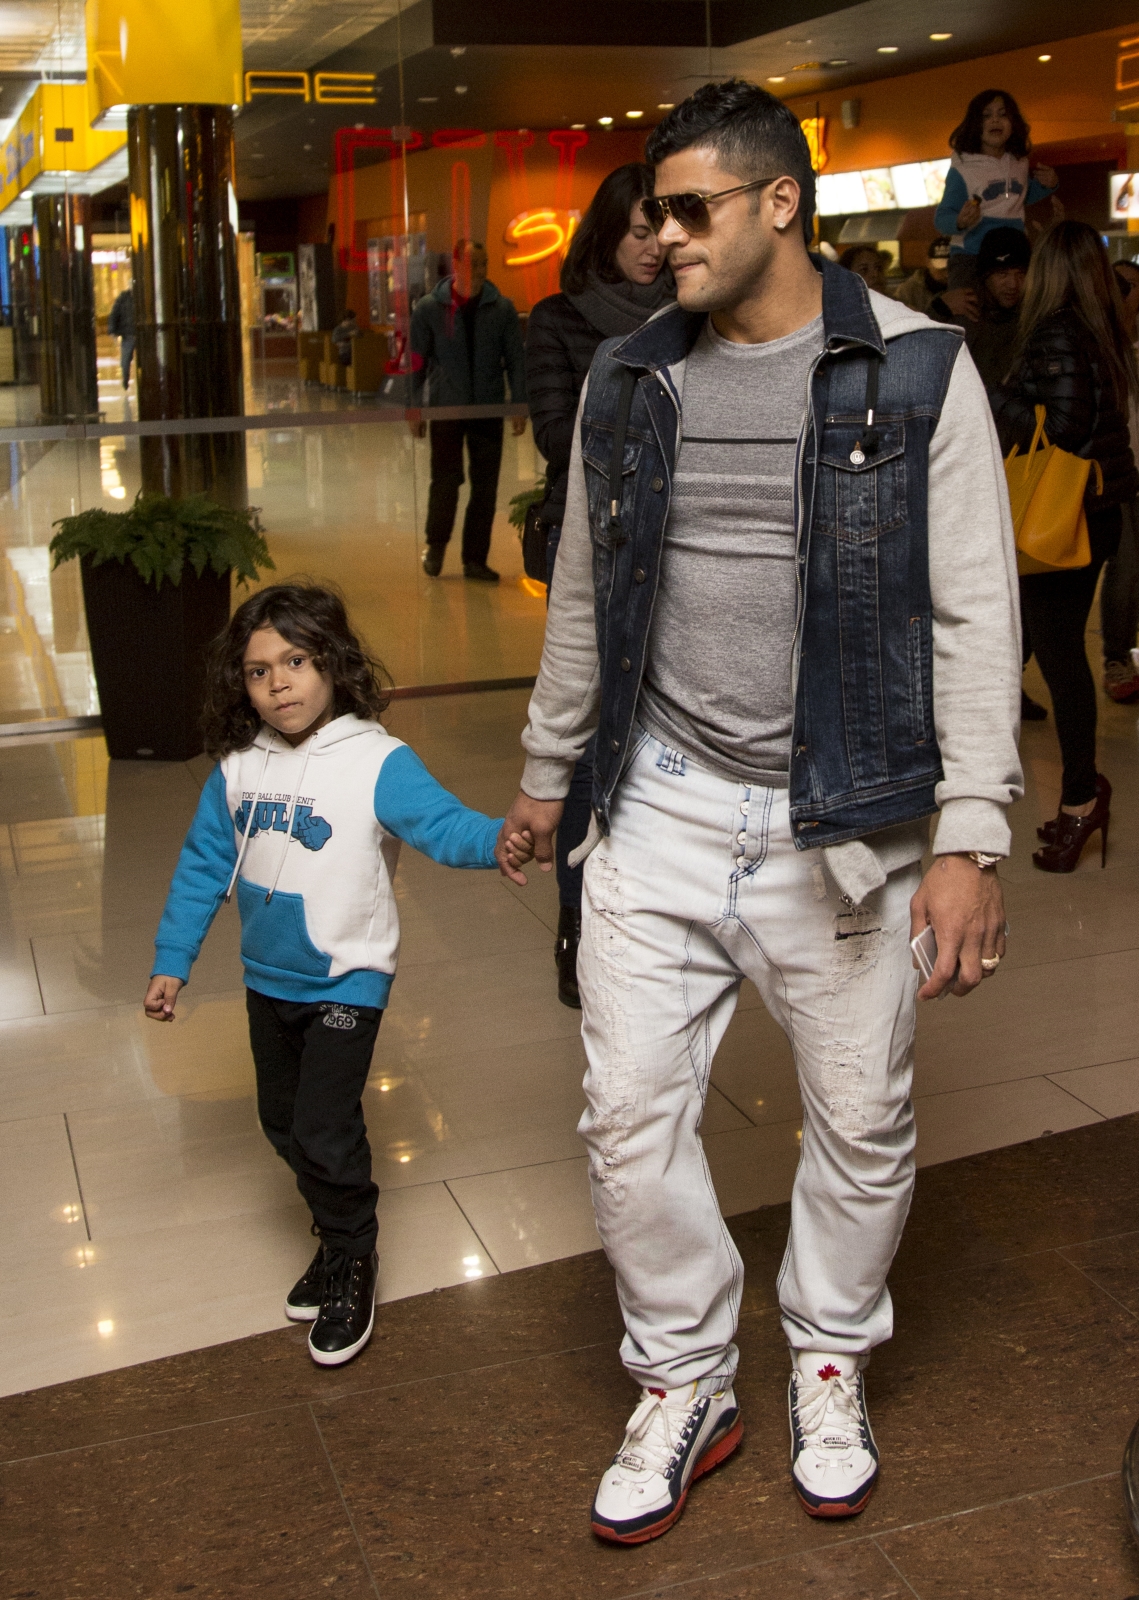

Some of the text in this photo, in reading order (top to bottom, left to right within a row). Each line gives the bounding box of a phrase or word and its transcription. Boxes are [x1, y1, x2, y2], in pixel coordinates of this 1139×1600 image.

[274, 793, 292, 802] CLUB
[241, 800, 314, 833] HULK
[324, 1013, 354, 1028] 1969
